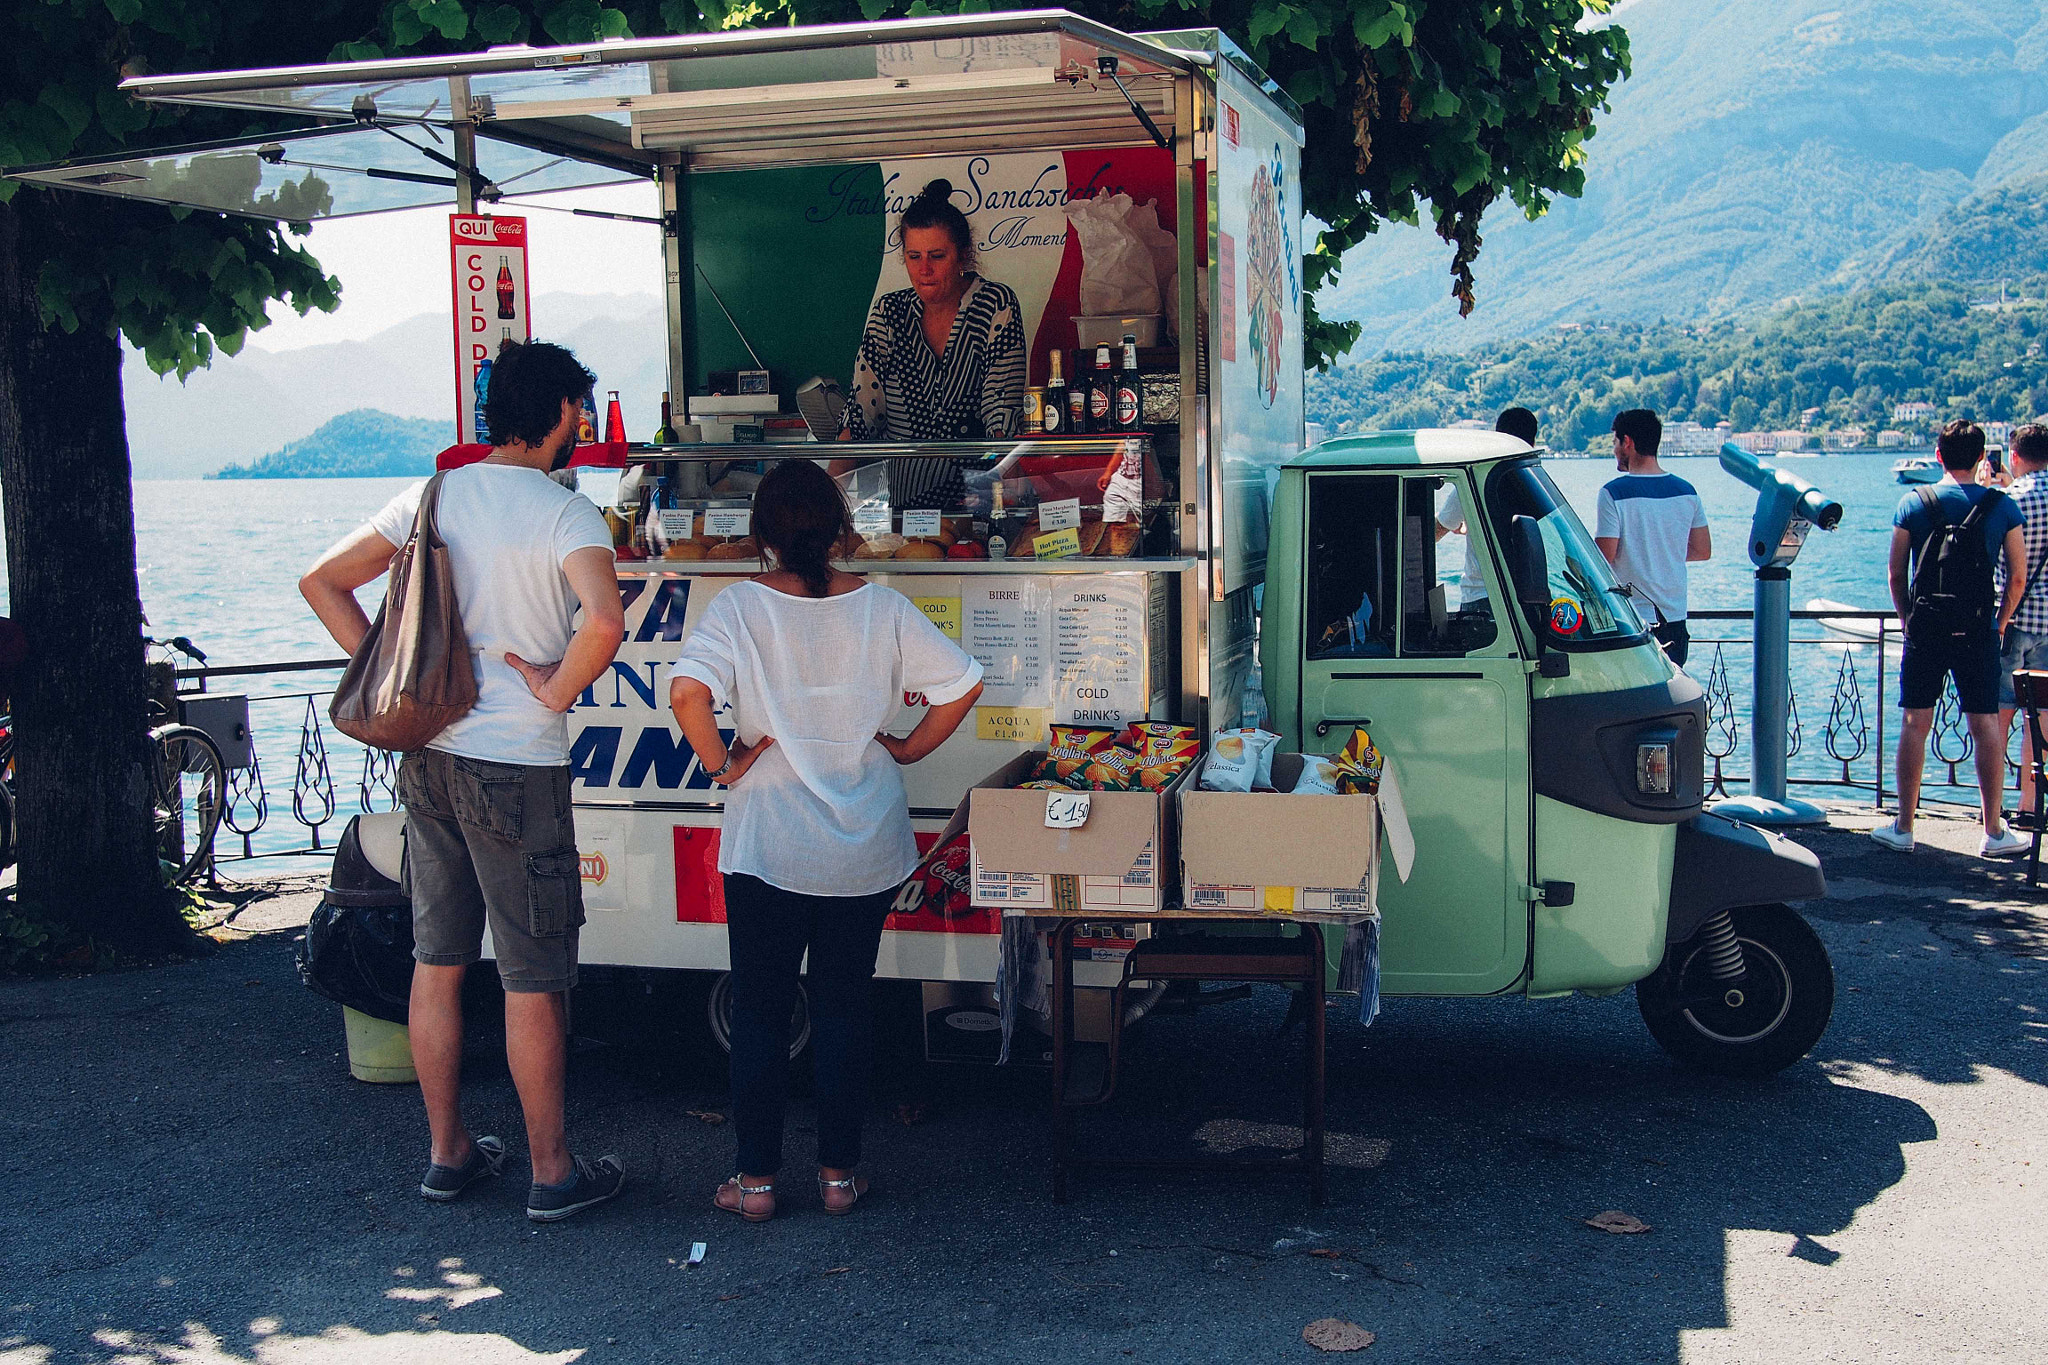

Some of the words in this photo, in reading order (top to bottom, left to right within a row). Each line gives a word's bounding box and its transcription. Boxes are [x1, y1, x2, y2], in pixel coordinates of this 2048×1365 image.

[950, 157, 1125, 216] Sandwich
[459, 222, 487, 236] QUI
[467, 254, 487, 333] COLD
[1039, 542, 1051, 550] Hot
[1052, 537, 1069, 546] Pizza
[1060, 543, 1078, 552] Pizza
[989, 590, 1020, 600] BIRRE
[1073, 593, 1107, 602] DRINKS
[923, 604, 947, 613] COLD
[932, 620, 954, 630] NK'S
[1076, 687, 1109, 699] COLD
[988, 716, 1030, 726] ACQUA
[1073, 709, 1120, 721] DRINK'S
[581, 860, 600, 876] NI
